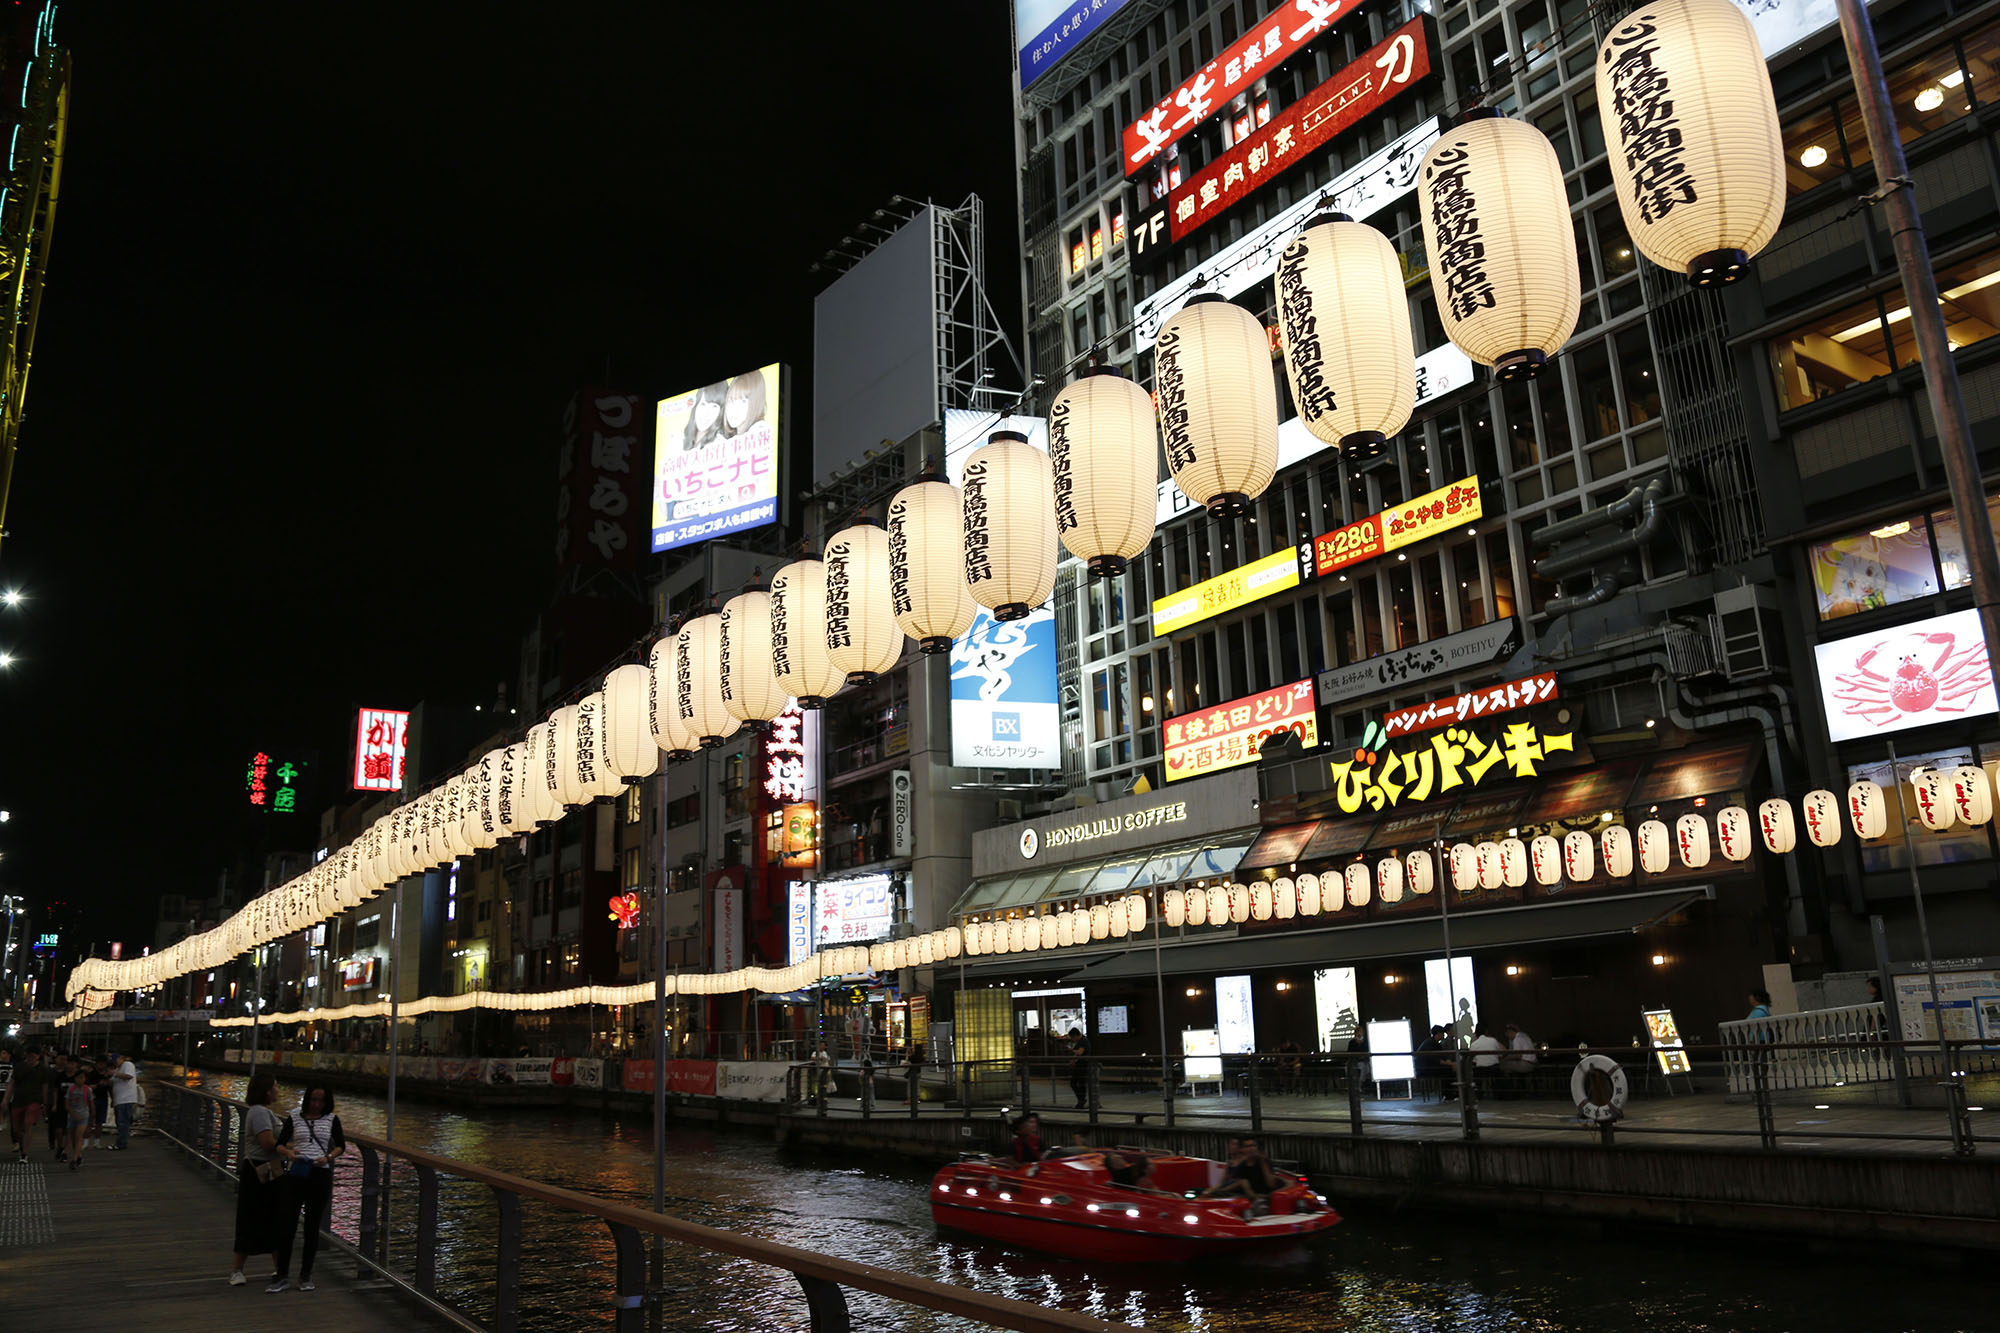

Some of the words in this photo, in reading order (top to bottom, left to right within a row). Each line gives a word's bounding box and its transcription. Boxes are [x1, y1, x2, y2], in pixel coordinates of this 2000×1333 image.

[1032, 0, 1108, 64] 住む人を思う気
[1224, 26, 1283, 87] 居楽屋
[1375, 34, 1414, 95] 刀
[1302, 78, 1373, 131] KATANA
[1175, 124, 1297, 224] 個室肉割烹
[1134, 210, 1165, 254] 7F
[1502, 641, 1516, 655] 2F
[1293, 680, 1312, 699] 2F
[1386, 676, 1557, 734] ハンバーグレストラン
[995, 718, 1018, 734] BX
[1165, 691, 1295, 748] 豊後高田どり
[972, 744, 1045, 758] 文化シャッター
[1188, 736, 1244, 769] 酒場
[1331, 722, 1575, 813] びっくりドンキー
[1045, 815, 1122, 848] HONOLULU
[1123, 801, 1188, 830] COFFEE
[841, 922, 869, 939] 免税
